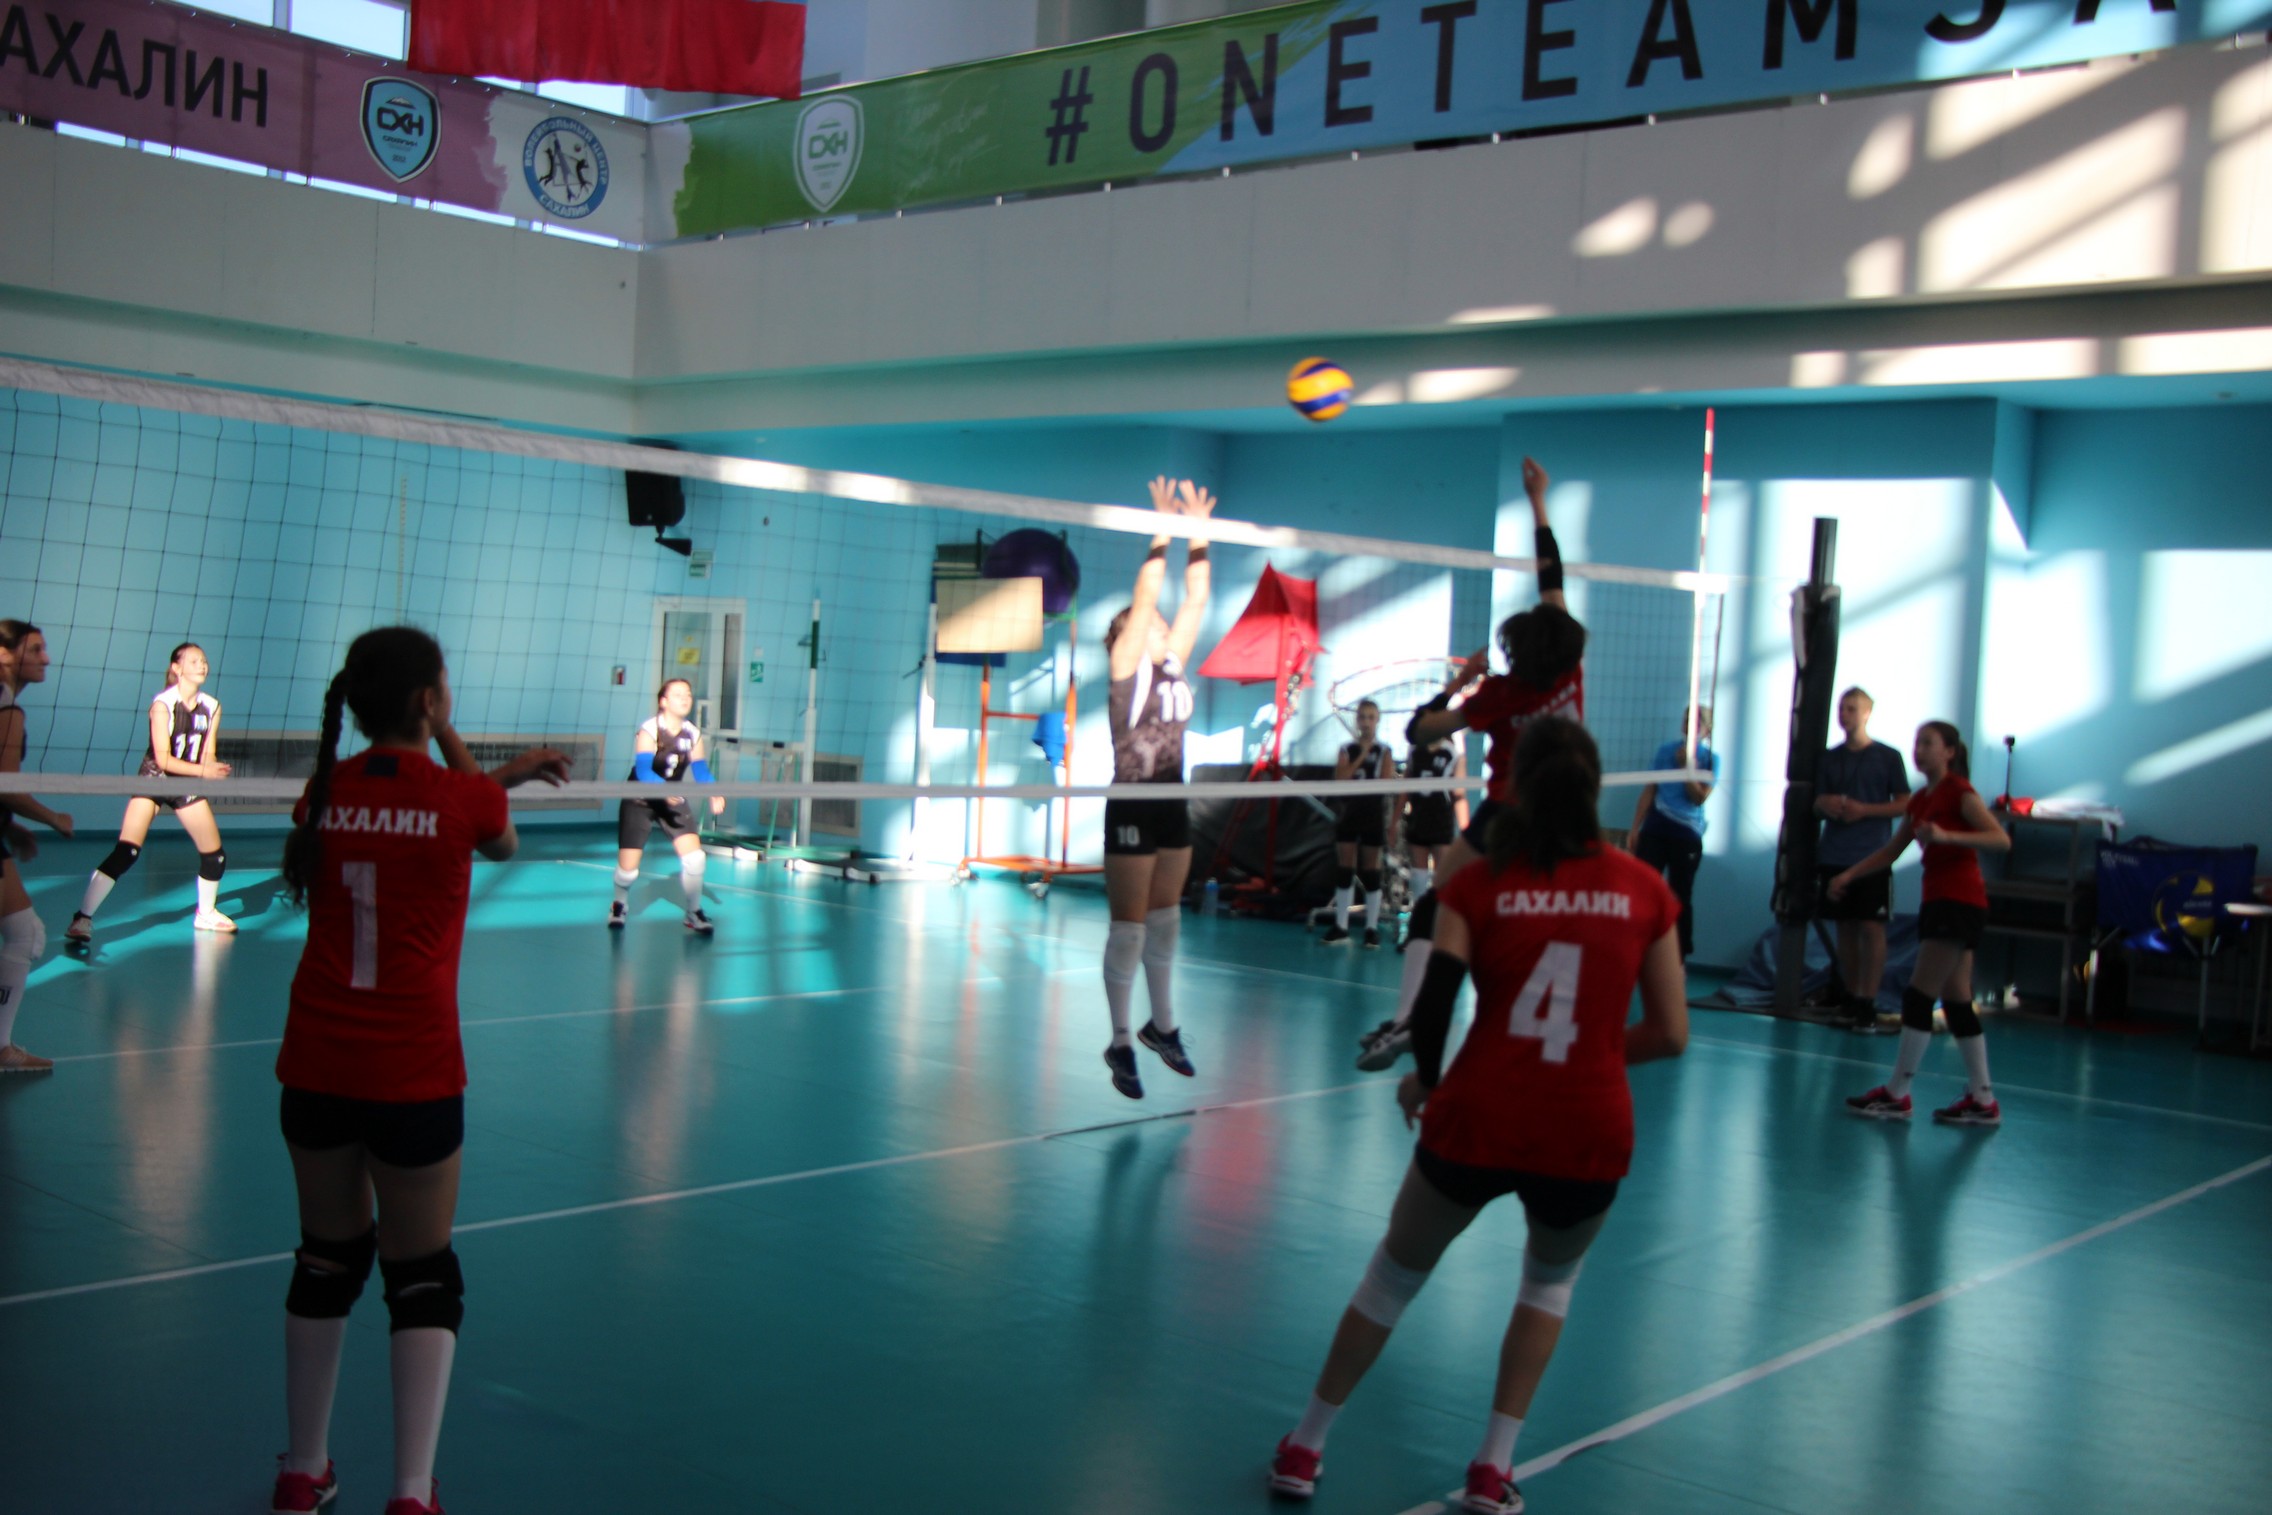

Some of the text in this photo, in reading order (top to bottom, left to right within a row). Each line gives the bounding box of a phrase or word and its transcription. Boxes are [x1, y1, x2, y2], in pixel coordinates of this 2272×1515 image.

[1045, 0, 2176, 166] #ONETEAM
[524, 119, 594, 168] ВОЛЕЙБОЛЬНЫЙ
[540, 194, 590, 216] САХАЛИН
[1157, 681, 1193, 722] 10
[175, 733, 202, 763] 11
[306, 806, 439, 838] АХАЛИН
[1116, 824, 1141, 846] 10
[1496, 890, 1631, 920] САХАЛИН
[342, 862, 377, 990] 1
[1508, 941, 1583, 1066] 4
